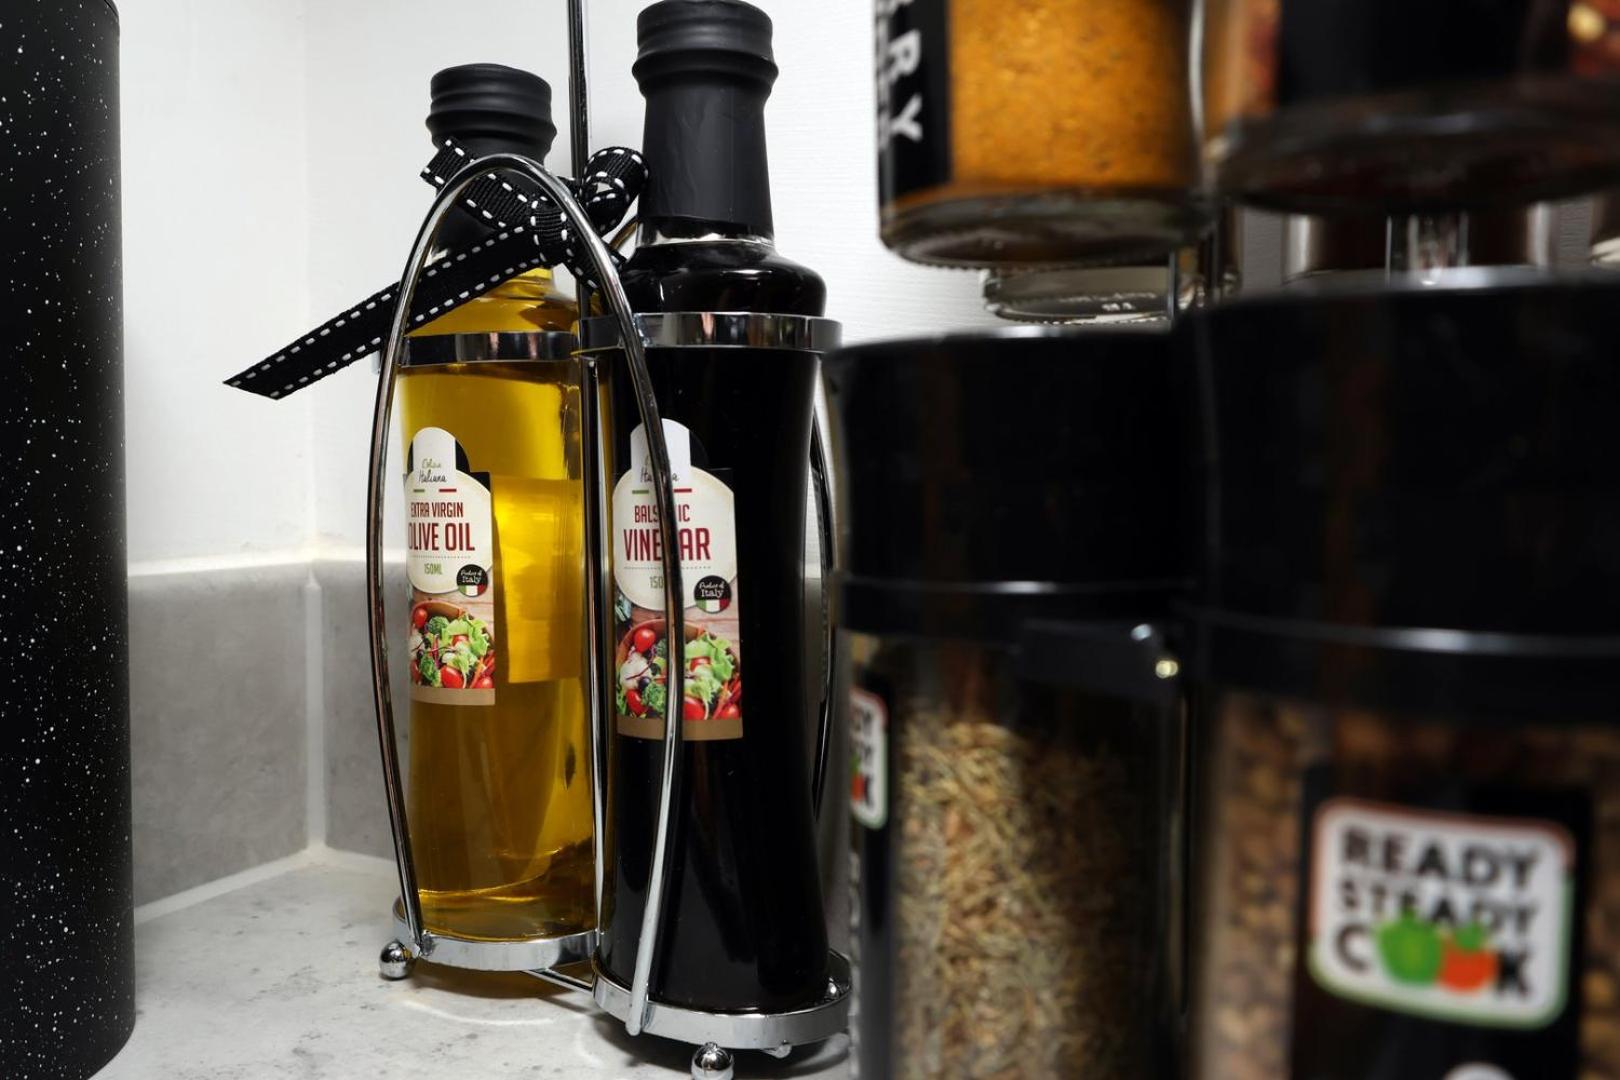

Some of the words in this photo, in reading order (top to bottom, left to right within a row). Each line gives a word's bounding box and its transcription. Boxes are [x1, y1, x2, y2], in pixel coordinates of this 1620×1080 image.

[882, 0, 923, 142] RY
[418, 469, 447, 483] Italiana
[411, 502, 430, 518] EXTRA
[431, 502, 464, 518] VIRGIN
[634, 504, 691, 523] BALSIC
[408, 522, 439, 551] OLIVE
[444, 522, 476, 551] OIL
[623, 528, 711, 562] VINEAR
[424, 563, 443, 575] 150ML
[462, 575, 482, 584] Italy
[701, 589, 724, 599] Italy
[1341, 826, 1539, 888] READY
